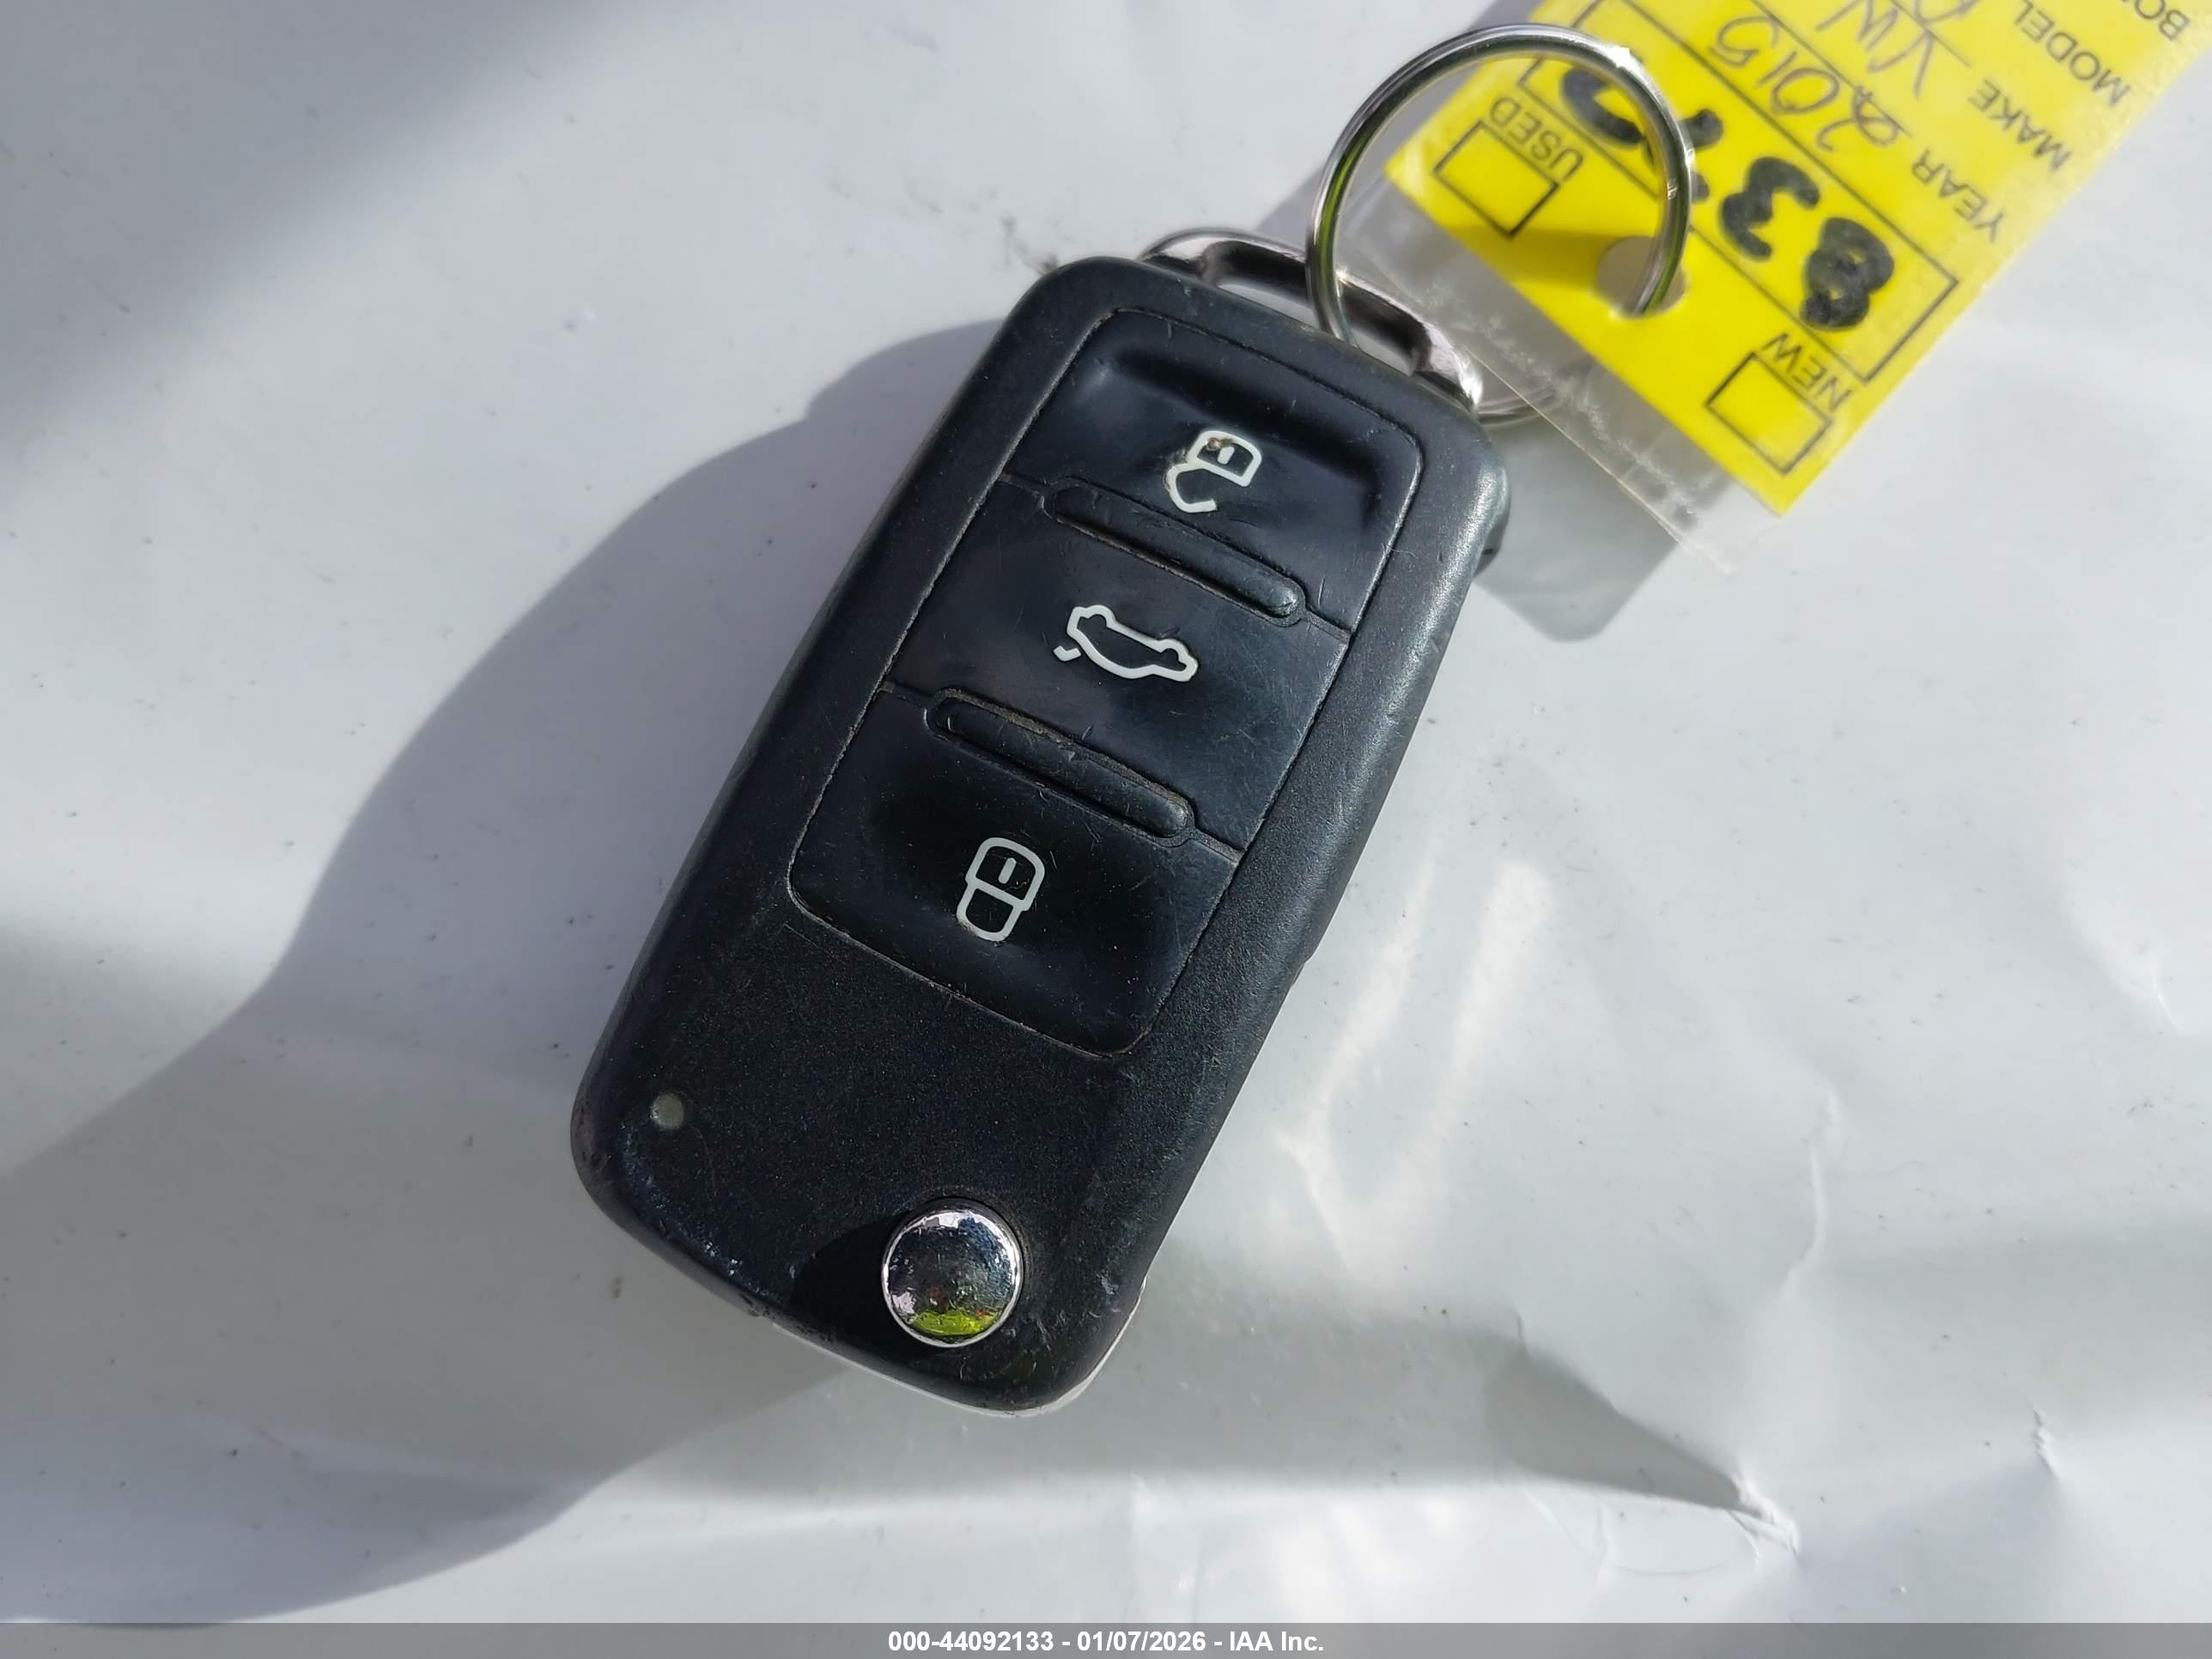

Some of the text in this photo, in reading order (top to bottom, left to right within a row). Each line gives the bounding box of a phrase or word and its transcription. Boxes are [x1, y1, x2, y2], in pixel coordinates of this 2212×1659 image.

[2012, 0, 2131, 107] MODEL
[2118, 0, 2190, 41] BO
[1708, 15, 1899, 153] 2015
[1968, 77, 2073, 172] MAKE
[1489, 94, 1585, 174] USED
[1911, 149, 2006, 244] YEAR
[1765, 331, 1855, 413] NEW
